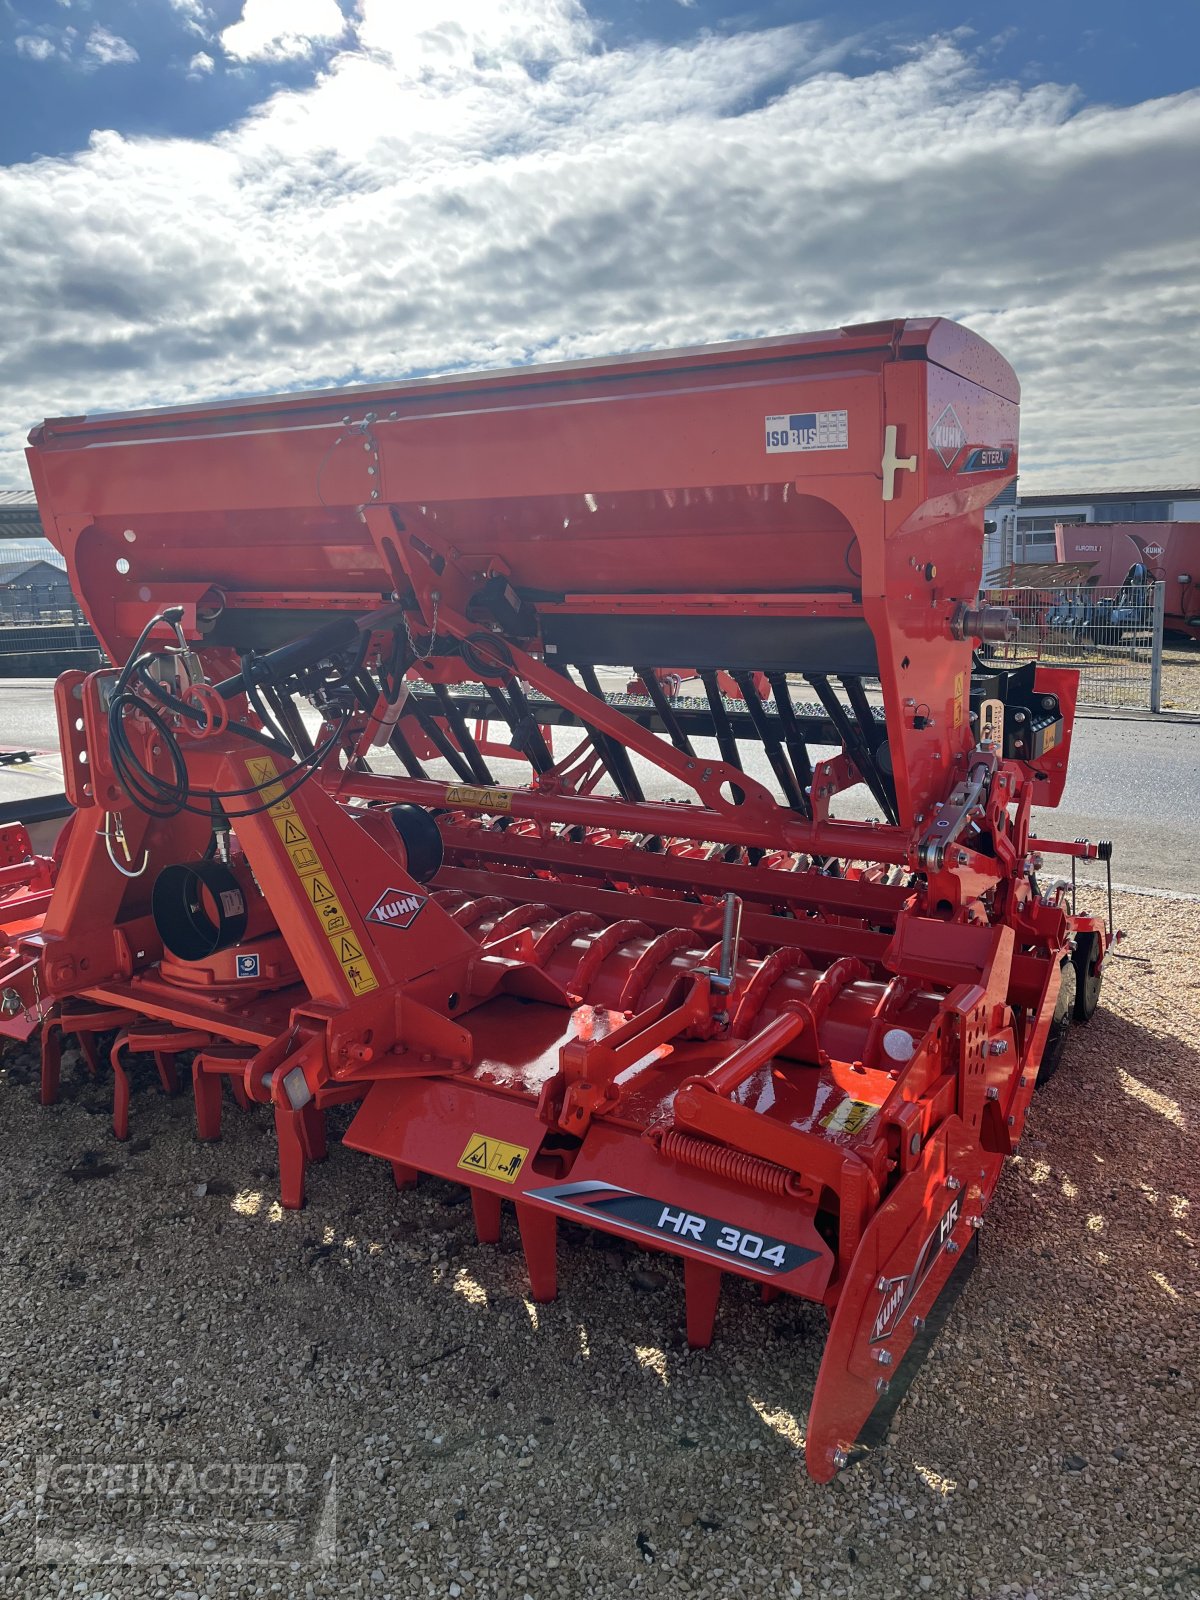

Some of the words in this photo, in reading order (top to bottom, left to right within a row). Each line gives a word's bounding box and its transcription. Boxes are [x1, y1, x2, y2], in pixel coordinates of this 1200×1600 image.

[766, 428, 817, 447] ISOBUS
[935, 425, 961, 448] KUHN
[981, 451, 1004, 465] SITERA
[1145, 546, 1162, 554] KUHN
[375, 896, 420, 921] KUHN
[940, 1199, 958, 1243] HR
[657, 1207, 706, 1241] HR
[716, 1226, 786, 1267] 304
[876, 1280, 905, 1336] KUHN
